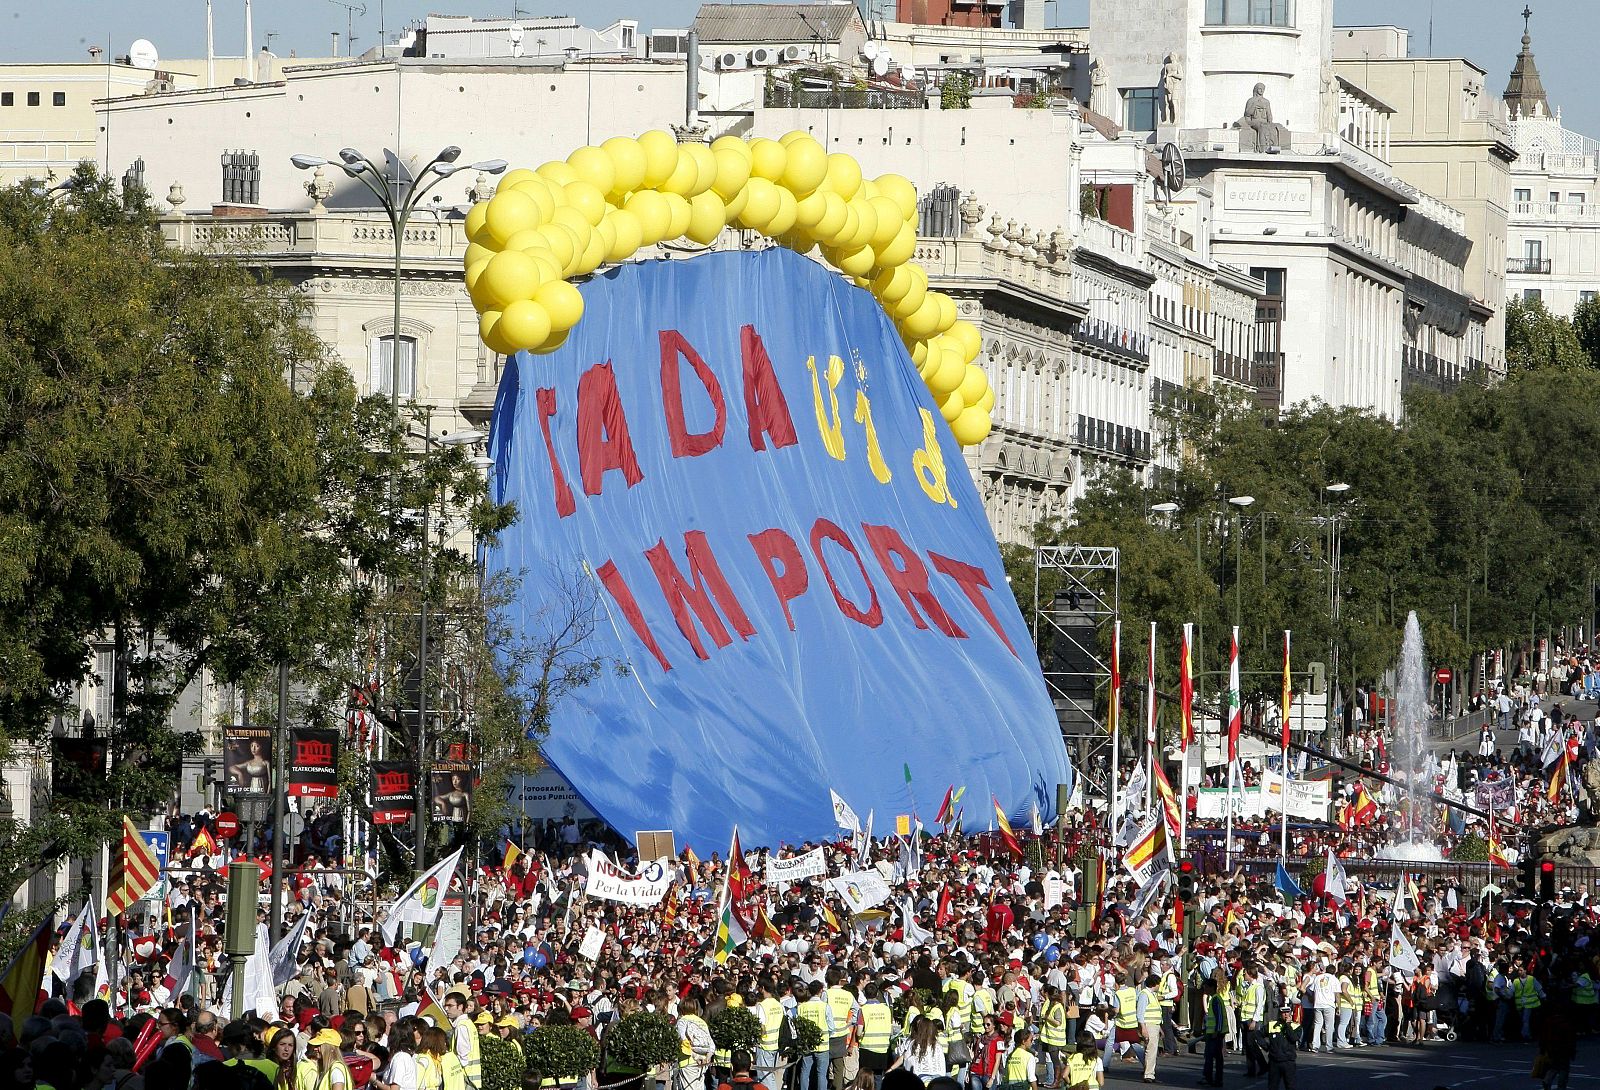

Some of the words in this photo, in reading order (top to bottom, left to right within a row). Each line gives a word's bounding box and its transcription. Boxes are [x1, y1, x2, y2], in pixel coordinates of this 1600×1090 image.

[1229, 189, 1306, 203] equitativa
[226, 729, 271, 737] CLEMENTINA
[431, 763, 470, 771] CLEMENTINA
[595, 880, 615, 893] Per
[617, 884, 628, 896] la
[632, 884, 662, 899] Vida
